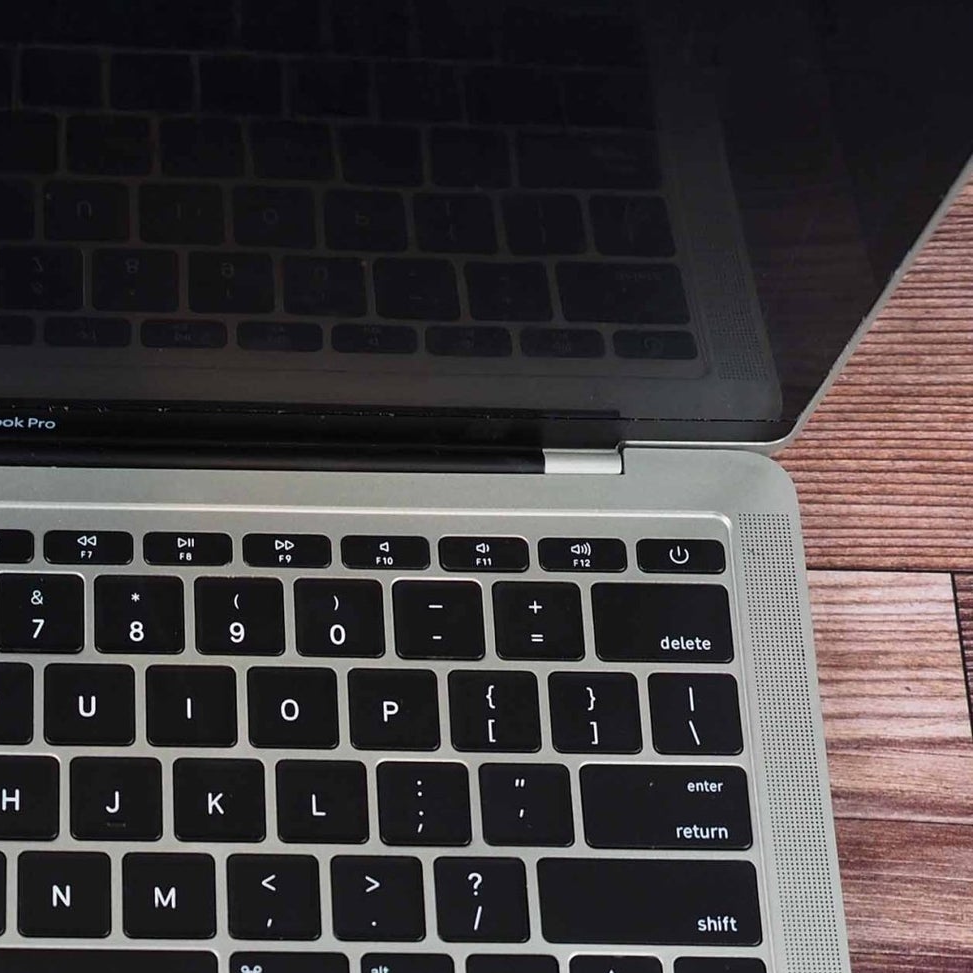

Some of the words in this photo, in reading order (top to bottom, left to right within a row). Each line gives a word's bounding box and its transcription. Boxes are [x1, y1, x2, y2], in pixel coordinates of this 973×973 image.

[27, 416, 56, 430] Pro
[80, 550, 93, 559] F7
[179, 551, 193, 562] F8
[278, 554, 292, 564] F9
[376, 556, 393, 566] F10
[476, 557, 491, 566] F11
[573, 558, 590, 568] F12
[30, 590, 44, 605] &
[232, 594, 240, 609] (
[333, 596, 340, 610] )
[528, 600, 543, 614] +
[31, 619, 45, 638] 7
[130, 621, 144, 641] 8
[230, 622, 244, 643] 9
[330, 624, 345, 645] 0
[661, 636, 711, 650] delete
[79, 696, 96, 717] U
[485, 685, 496, 709] {
[585, 687, 596, 710] }
[281, 699, 299, 721] O
[383, 701, 398, 722] P
[487, 719, 497, 742] [
[589, 722, 599, 744] ]
[688, 721, 701, 745] \
[687, 780, 723, 793] enter
[2, 789, 19, 811] H
[105, 791, 120, 813] J
[208, 793, 224, 814] K
[312, 794, 326, 816] L
[676, 825, 728, 839] return
[261, 875, 276, 891] <
[365, 876, 380, 892] >
[468, 873, 482, 896] ?
[53, 885, 70, 907] N
[155, 887, 176, 908] M
[473, 906, 483, 930] /
[698, 915, 737, 931] shift
